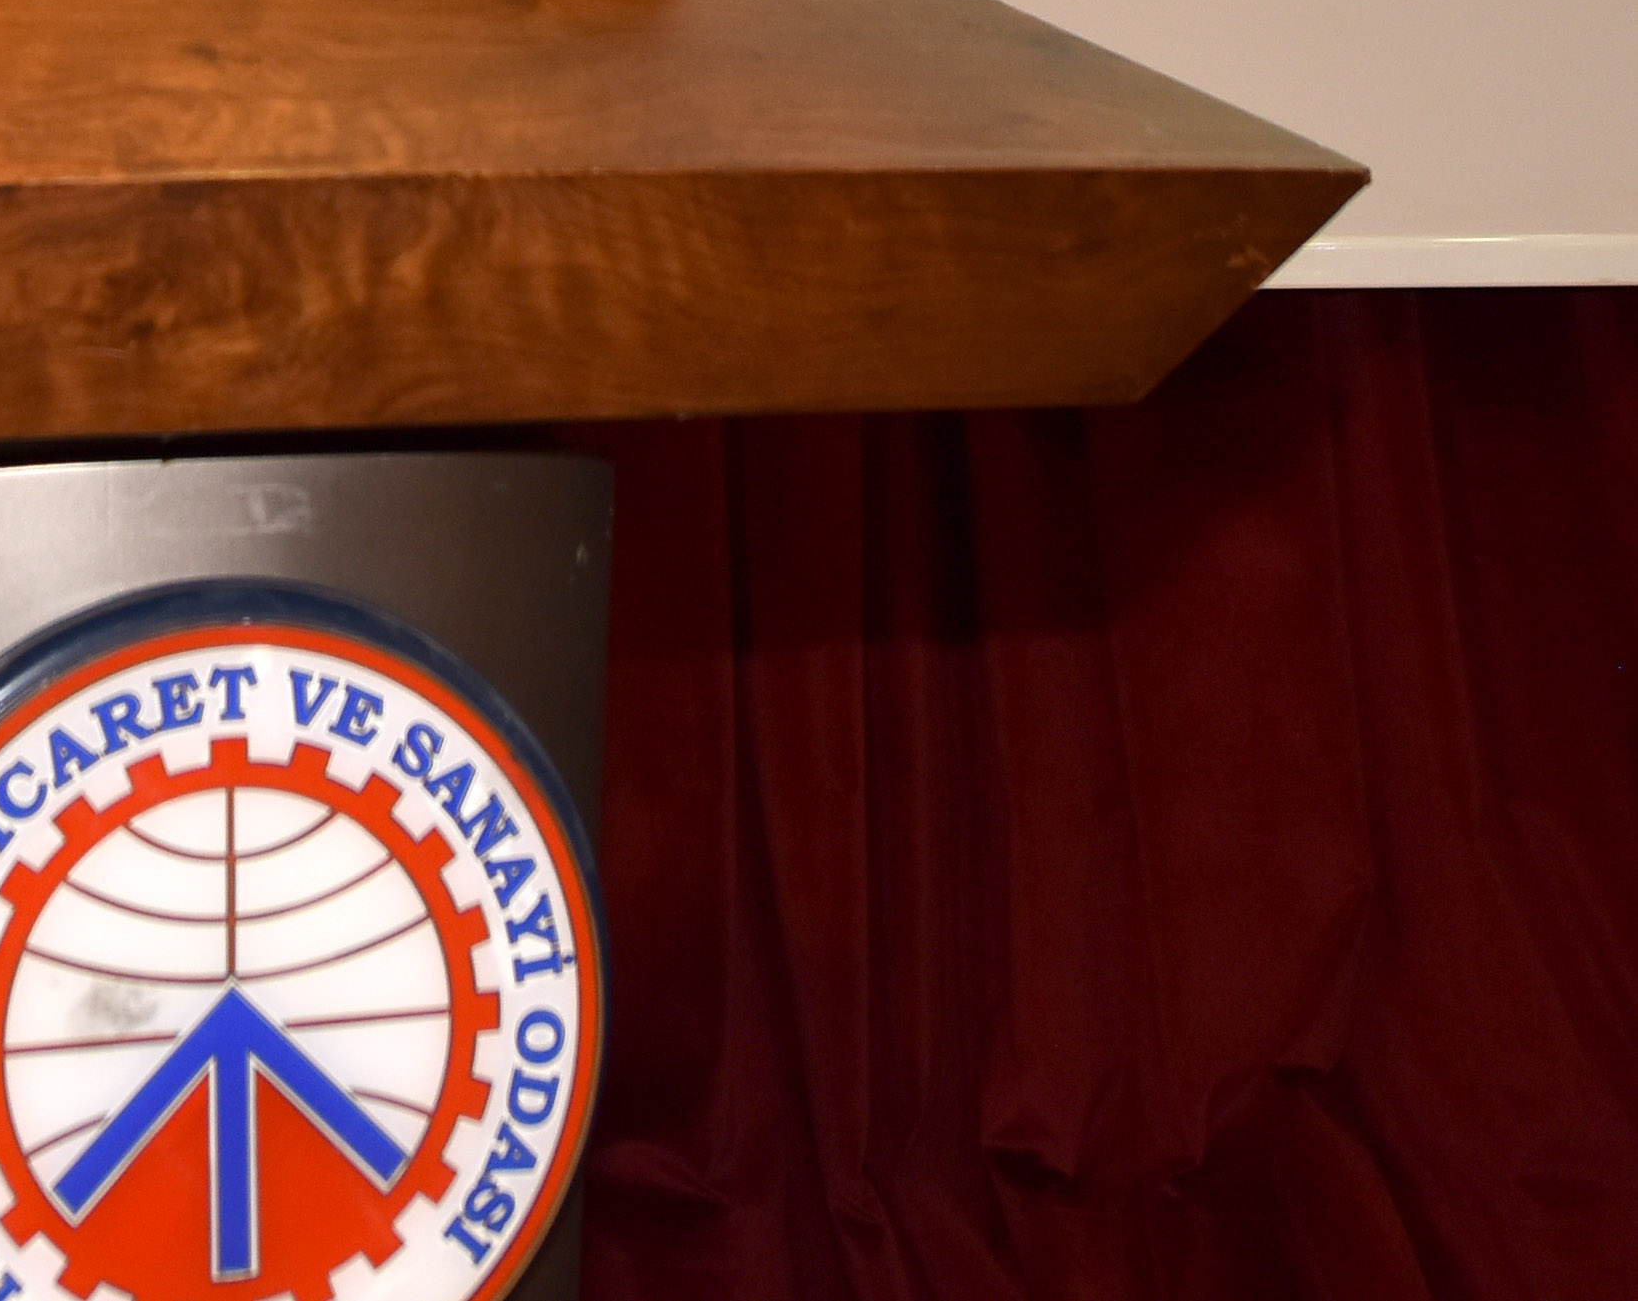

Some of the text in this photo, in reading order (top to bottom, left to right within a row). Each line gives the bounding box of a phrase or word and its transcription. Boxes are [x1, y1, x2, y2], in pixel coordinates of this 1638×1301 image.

[288, 668, 387, 748] VE
[391, 721, 578, 984] SANAYİ
[444, 1008, 566, 1265] ODASI
